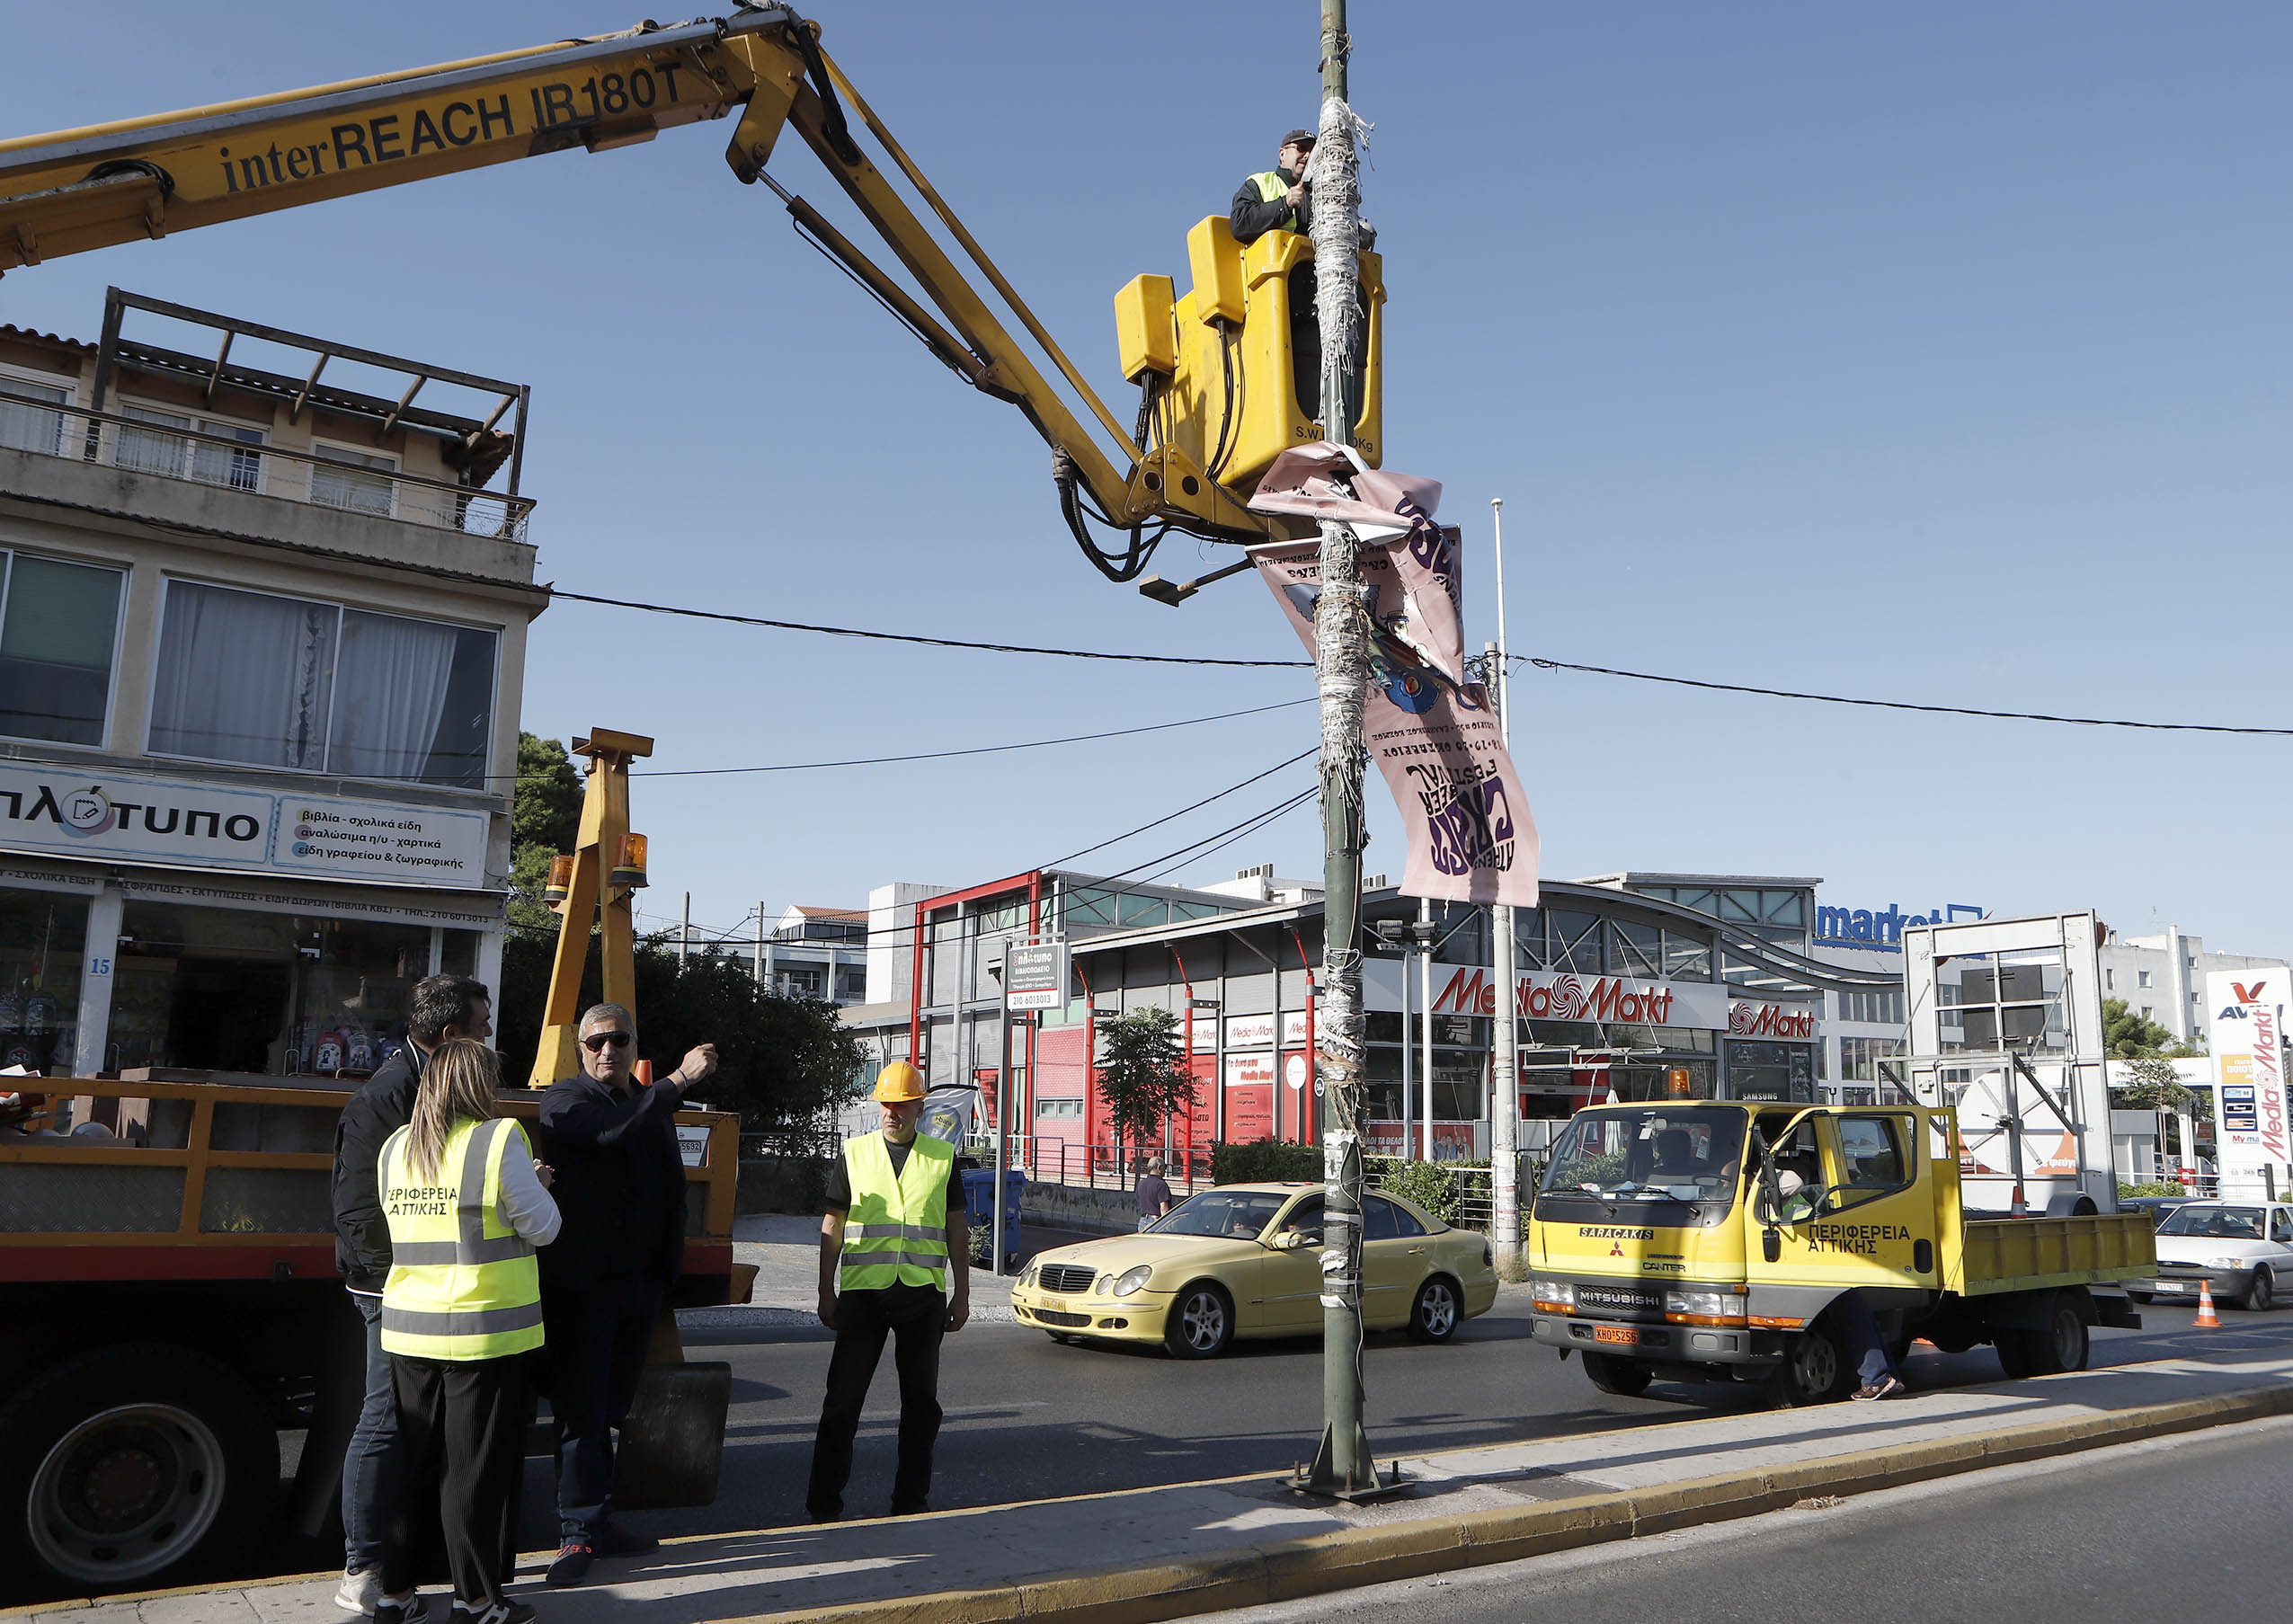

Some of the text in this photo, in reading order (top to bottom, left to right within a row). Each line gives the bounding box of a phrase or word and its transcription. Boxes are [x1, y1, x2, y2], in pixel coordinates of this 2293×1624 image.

[220, 62, 683, 194] interREACH IR180T
[1405, 759, 1498, 792] FESTIVAL
[1418, 784, 1458, 816] BEER
[302, 811, 422, 832] βιβλία σχολικά είδη
[301, 828, 441, 849] αναλώσιμα η/υ χαρτικά
[298, 845, 464, 869] είδη γραφείου & ζωγραφικής
[1473, 839, 1515, 872] ATHENS
[90, 957, 111, 975] 15
[1013, 994, 1051, 1006] 210 6013013
[1575, 977, 1674, 1023] Markt
[1749, 1004, 1815, 1038] Markt
[2253, 1008, 2286, 1161] Media Markt
[1742, 1092, 1778, 1101] SAMSUNG
[387, 1187, 458, 1202] ΕΡΙΦΕΡΕΙΑ
[388, 1202, 447, 1216] ΑΤΤΙΚΗΣ
[1580, 1227, 1653, 1239] SARACAKIS
[1809, 1224, 1911, 1240] ΠΕΡΙΦΕΡΕΙΑ
[1809, 1238, 1878, 1255] ΑΤΤΙΚΗΣ
[1642, 1262, 1686, 1273] CANTER
[1580, 1291, 1659, 1306] MITSUBISHI
